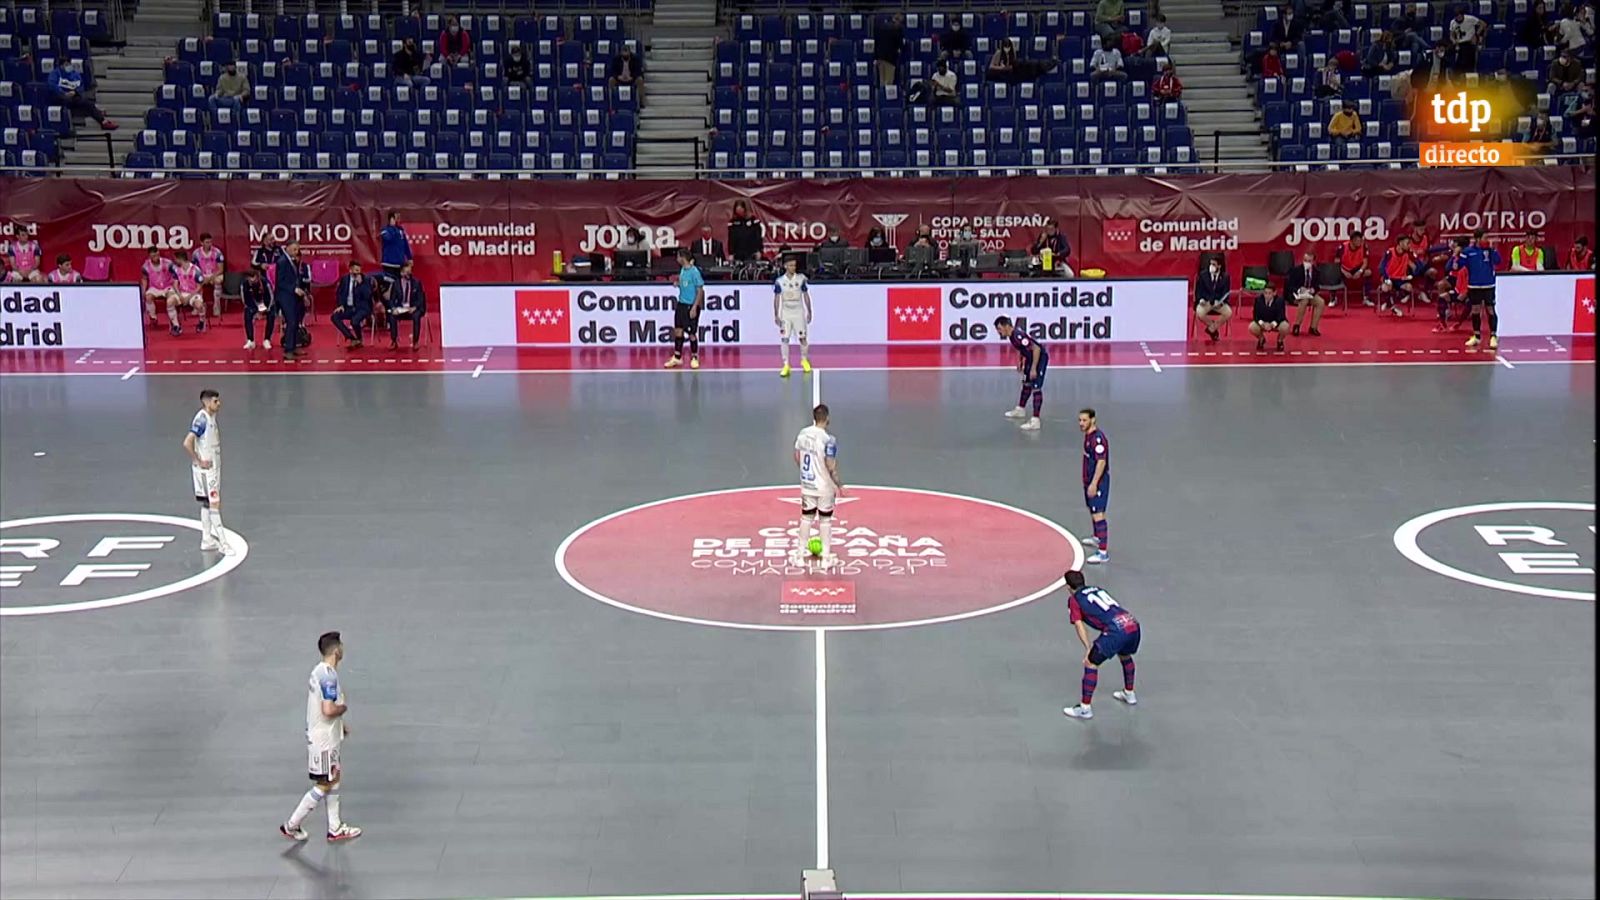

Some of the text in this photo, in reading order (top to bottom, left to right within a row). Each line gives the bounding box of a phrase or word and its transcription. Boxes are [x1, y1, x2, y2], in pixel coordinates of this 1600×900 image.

[437, 222, 536, 236] Comunidad
[931, 216, 968, 227] COPA
[973, 216, 992, 227] DE
[1140, 217, 1239, 232] Comunidad
[980, 229, 1011, 238] SALA
[438, 240, 536, 256] de Madrid
[1140, 235, 1239, 252] de Madrid
[0, 291, 62, 313] dad
[577, 289, 740, 311] Comunad
[949, 286, 1113, 308] Comunidad
[578, 320, 740, 344] de Marid
[949, 318, 988, 341] de
[802, 454, 811, 471] 9
[693, 535, 943, 549] DE EPAÑA
[848, 547, 946, 557] SALA
[907, 558, 948, 567] DE
[733, 567, 861, 576] MADRID
[1087, 590, 1120, 612] 14
